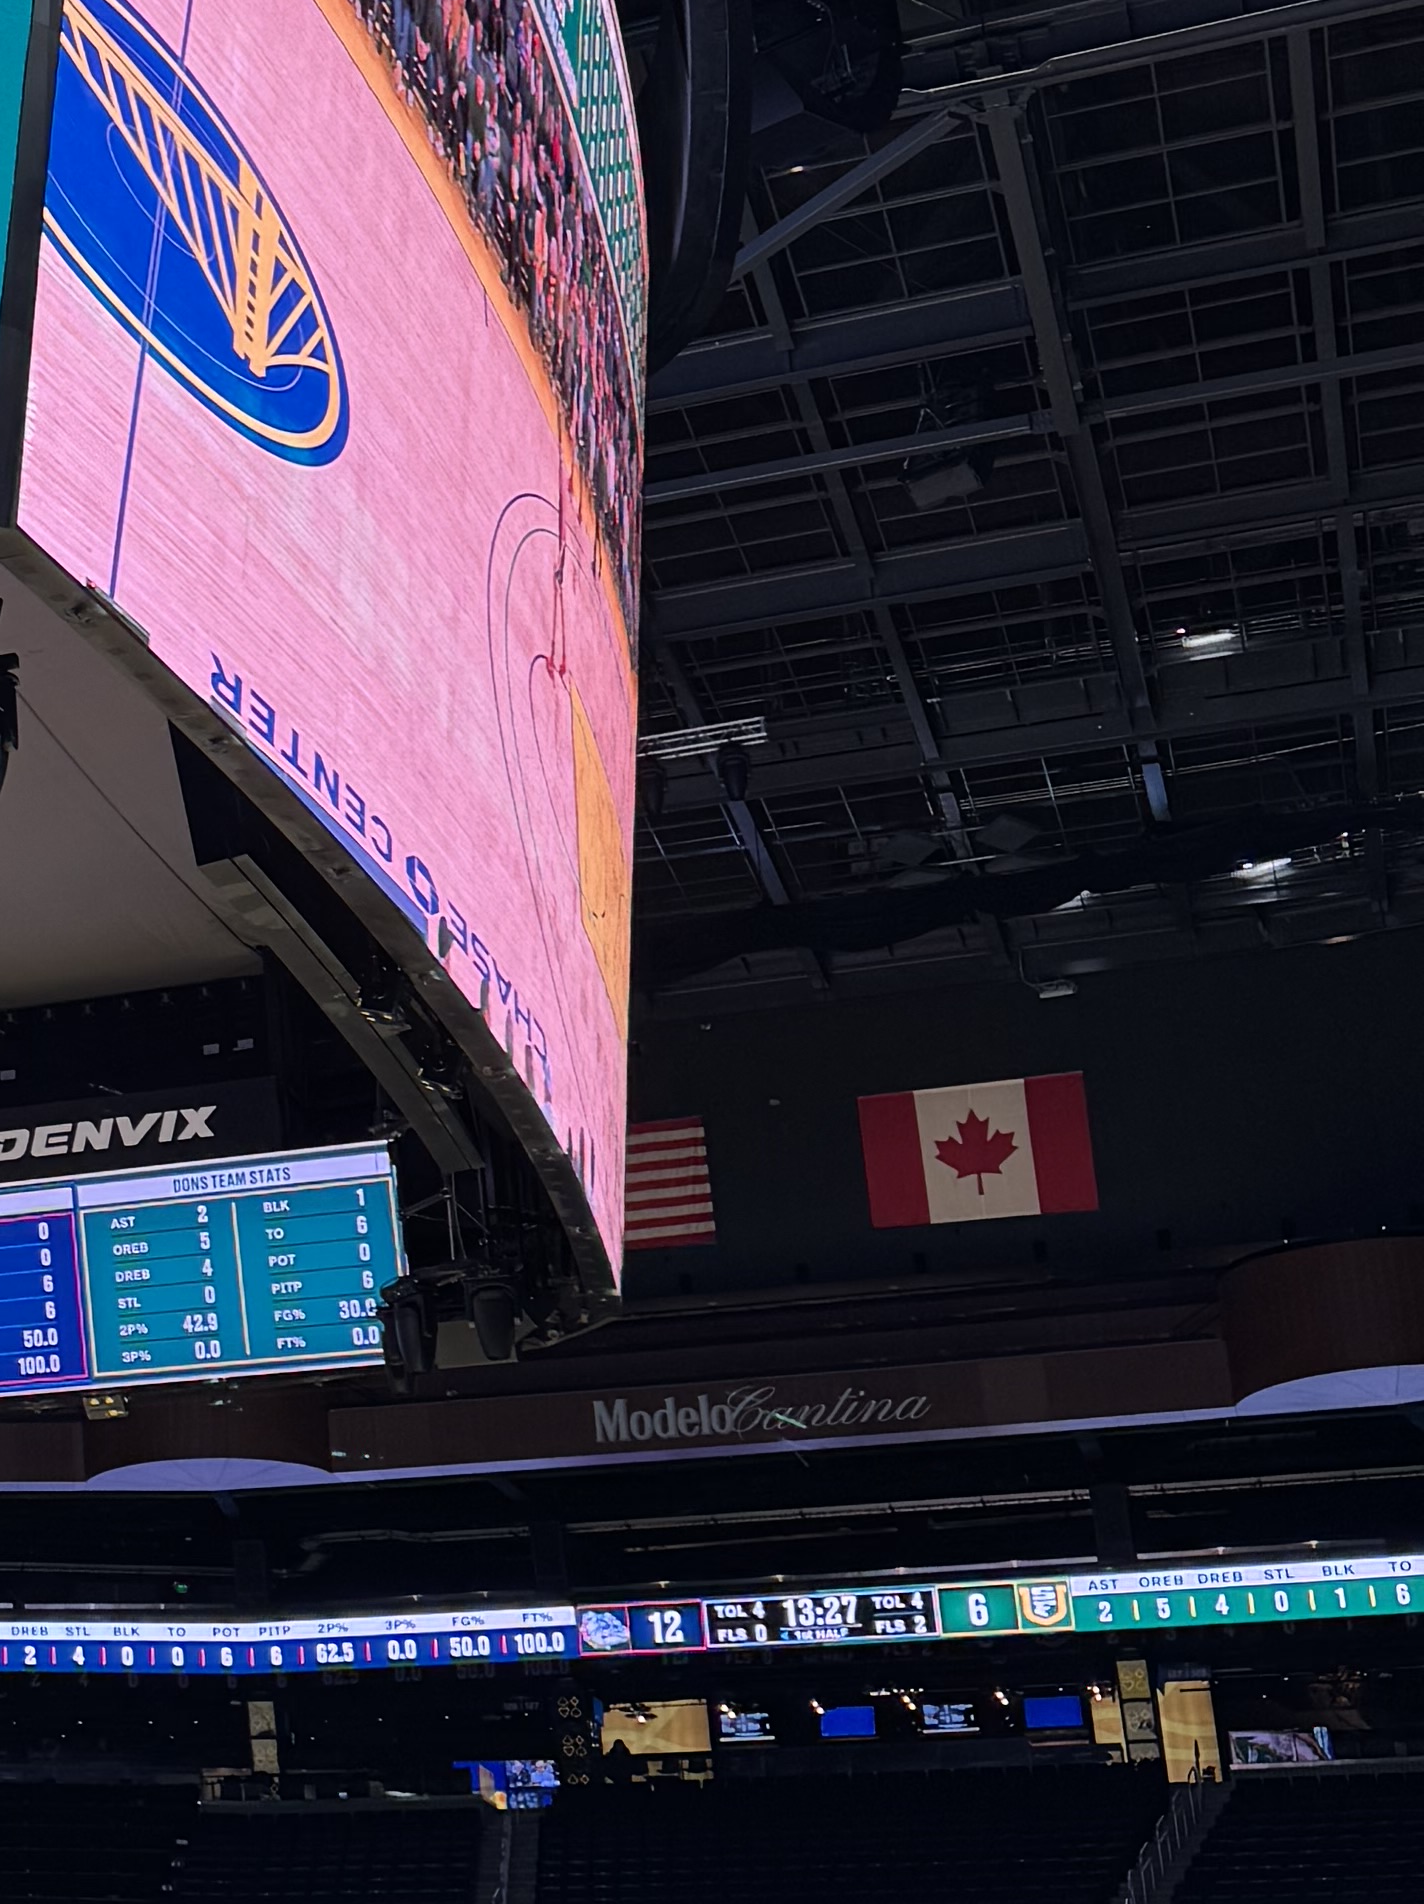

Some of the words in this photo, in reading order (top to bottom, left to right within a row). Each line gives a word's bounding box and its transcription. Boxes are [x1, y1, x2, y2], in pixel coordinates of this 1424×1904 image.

[172, 1175, 205, 1193] DONS
[207, 1171, 247, 1190] TEAM
[249, 1166, 291, 1186] STATS
[593, 1394, 735, 1443] Modelo
[727, 1385, 932, 1440] Cantina
[648, 1610, 684, 1644] 12
[782, 1596, 858, 1627] 13:27
[969, 1593, 988, 1627] 6
[316, 1642, 354, 1663] 62.5
[388, 1638, 417, 1660] 0.0
[450, 1635, 490, 1657] 50.0
[516, 1632, 565, 1655] 100.0
